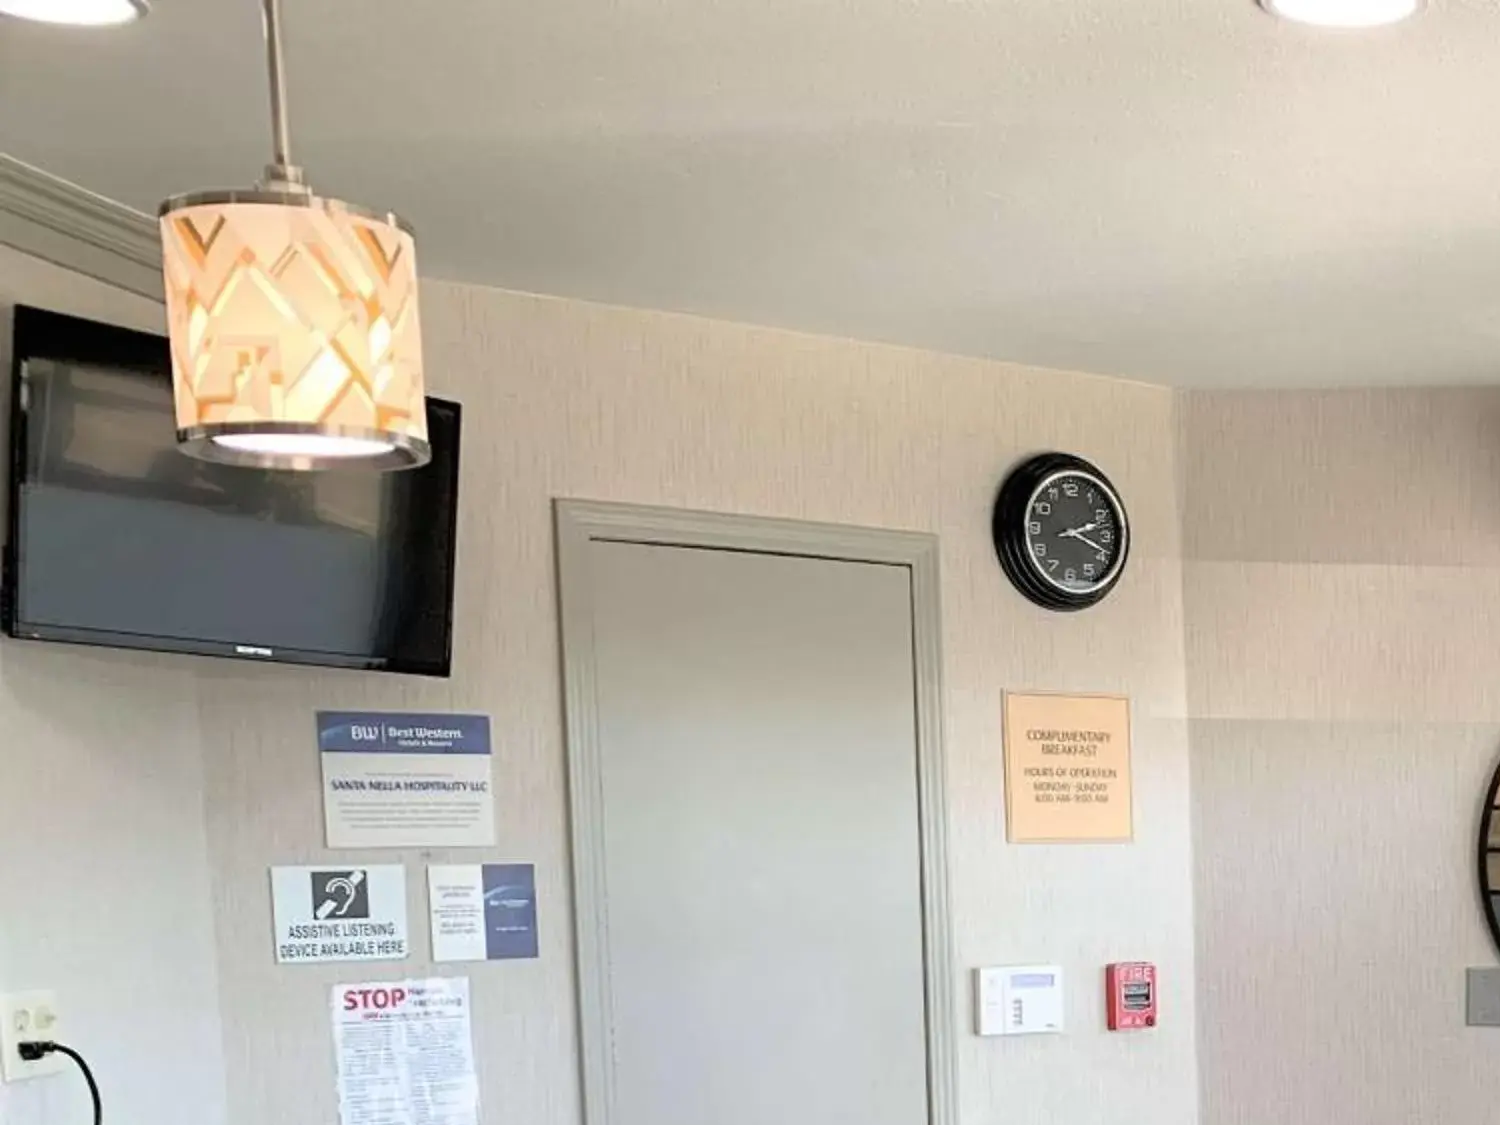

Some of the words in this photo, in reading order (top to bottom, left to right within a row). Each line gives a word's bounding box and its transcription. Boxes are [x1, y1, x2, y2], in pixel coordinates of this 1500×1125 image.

[1062, 483, 1079, 497] 12
[1087, 488, 1095, 504] 1
[1035, 502, 1051, 515] 10
[1096, 509, 1108, 522] 2
[1101, 531, 1111, 543] 3
[1047, 559, 1060, 572] 7
[1083, 563, 1095, 576] 5
[1065, 568, 1076, 582] 6
[351, 725, 379, 741] BW
[388, 728, 413, 740] Best
[415, 728, 462, 740] Western
[331, 779, 366, 791] SANTA
[369, 780, 401, 792] NELLA
[404, 780, 467, 792] HOSPITALITY
[471, 782, 489, 792] LLC
[288, 924, 341, 939] ASSISTIVE
[343, 922, 396, 937] LISTENING
[280, 943, 318, 959] DEVICE
[320, 941, 375, 956] AVAILABLE
[377, 939, 404, 955] HERE
[1121, 967, 1153, 981] FIRE
[343, 987, 406, 1011] STOP
